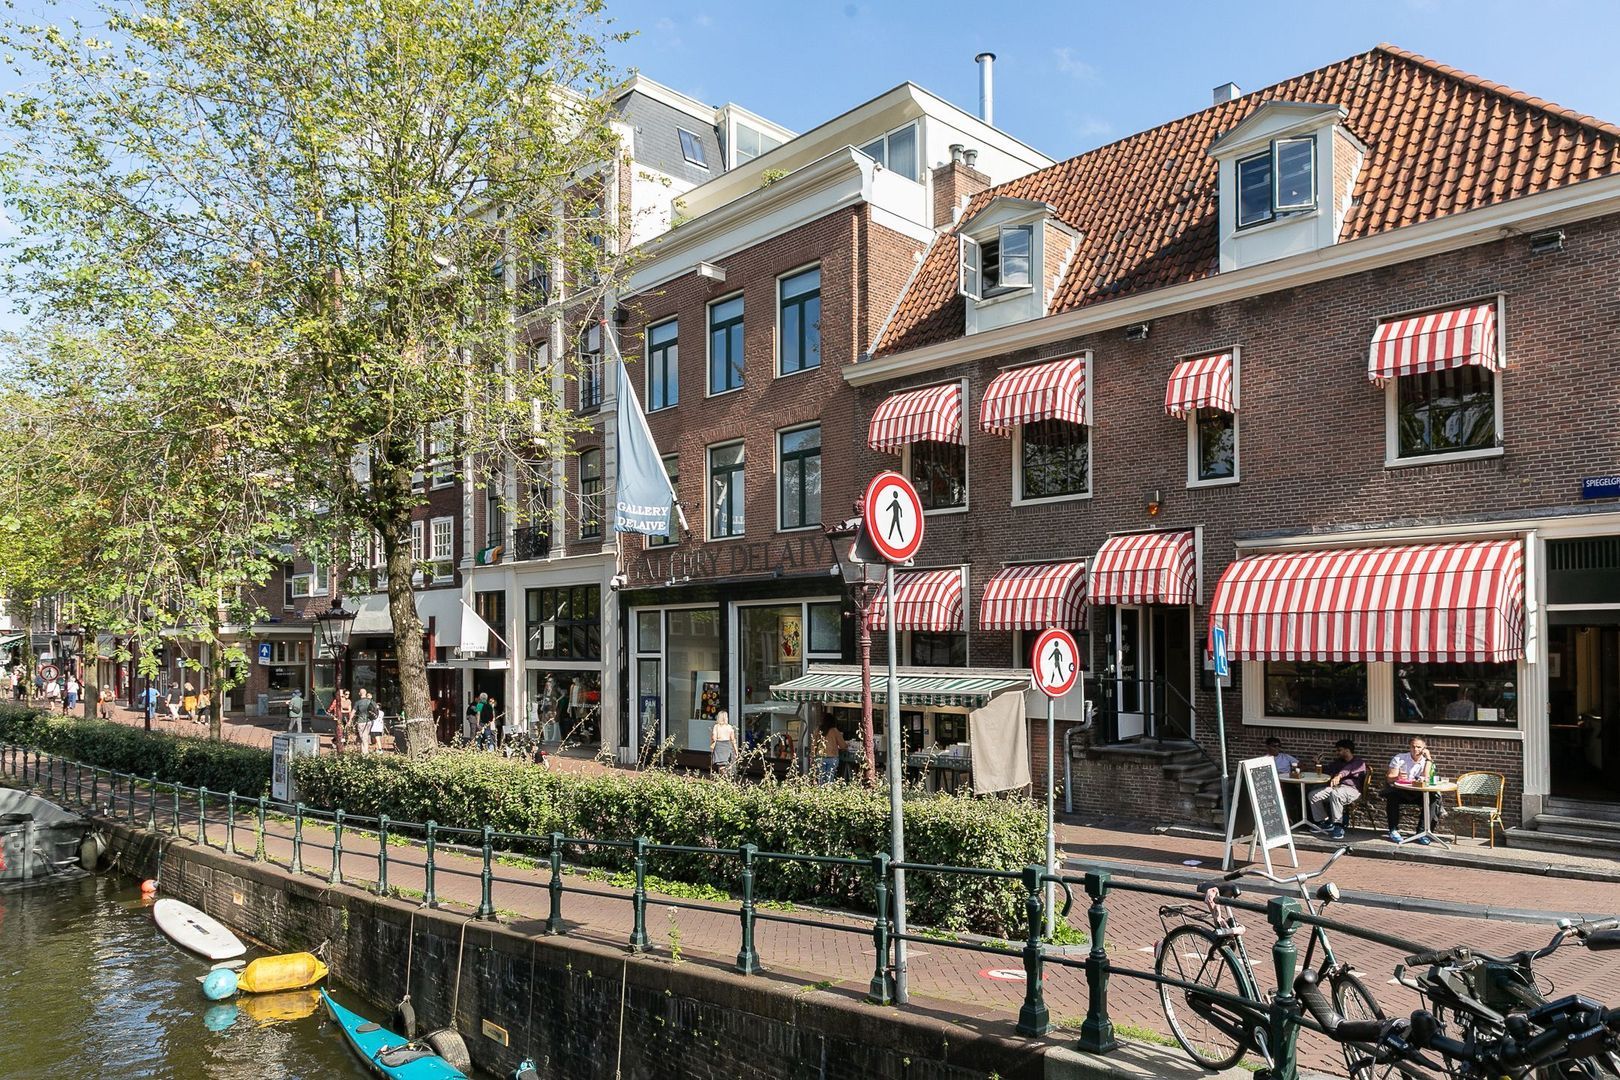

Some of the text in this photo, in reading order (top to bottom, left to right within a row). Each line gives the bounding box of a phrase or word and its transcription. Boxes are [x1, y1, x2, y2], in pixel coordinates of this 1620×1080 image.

[616, 502, 669, 516] GALLERY
[617, 516, 666, 531] DELAIVE
[729, 537, 838, 574] DELAIV
